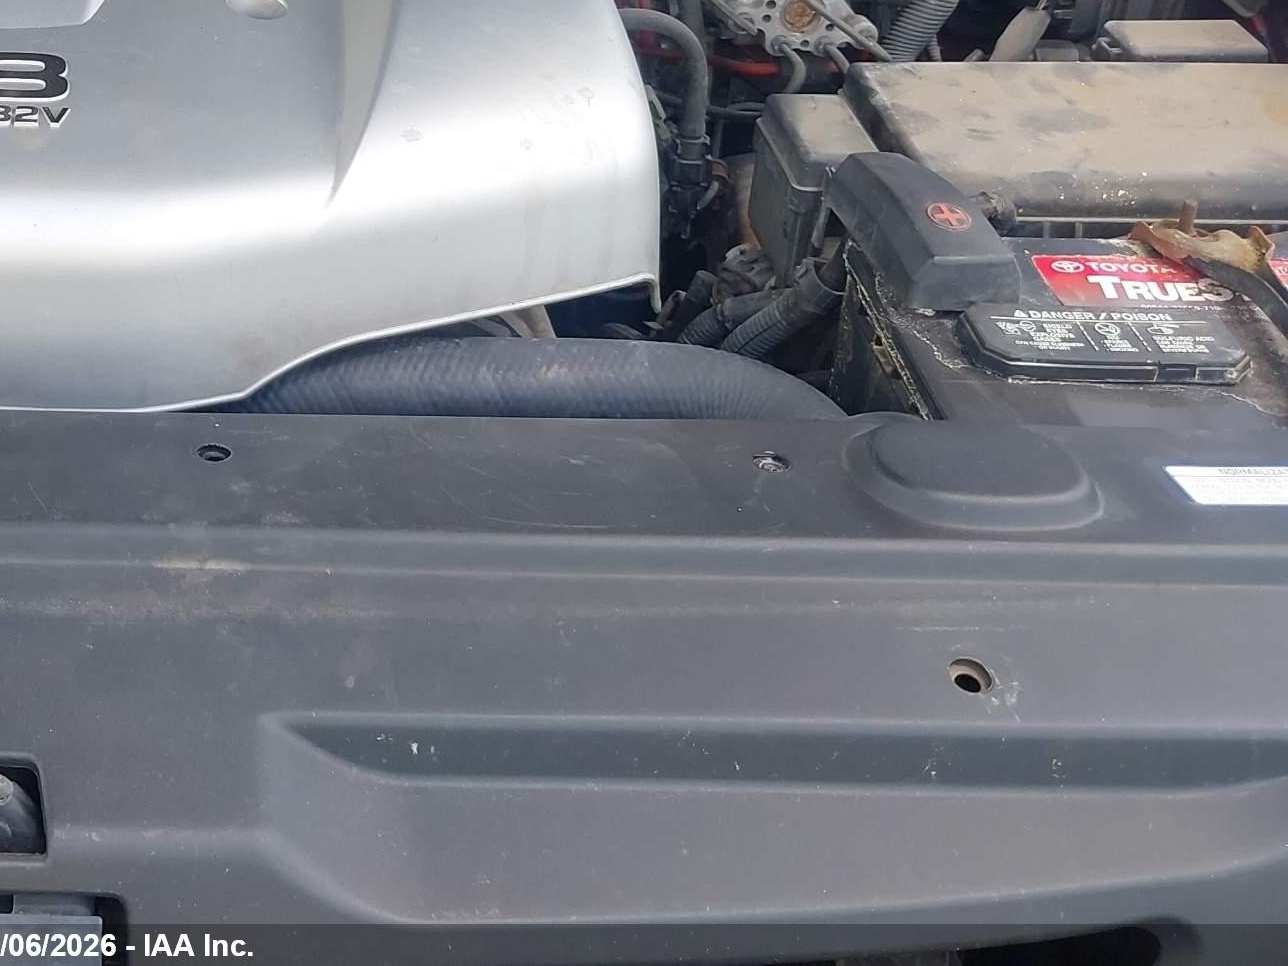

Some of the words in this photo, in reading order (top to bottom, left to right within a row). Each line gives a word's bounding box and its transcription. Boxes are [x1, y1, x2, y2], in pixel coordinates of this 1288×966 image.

[1084, 261, 1177, 274] TOYOTA
[1087, 275, 1251, 302] TRUES
[1028, 310, 1096, 320] DANGER
[1099, 312, 1107, 320] /
[1110, 312, 1173, 321] POISON
